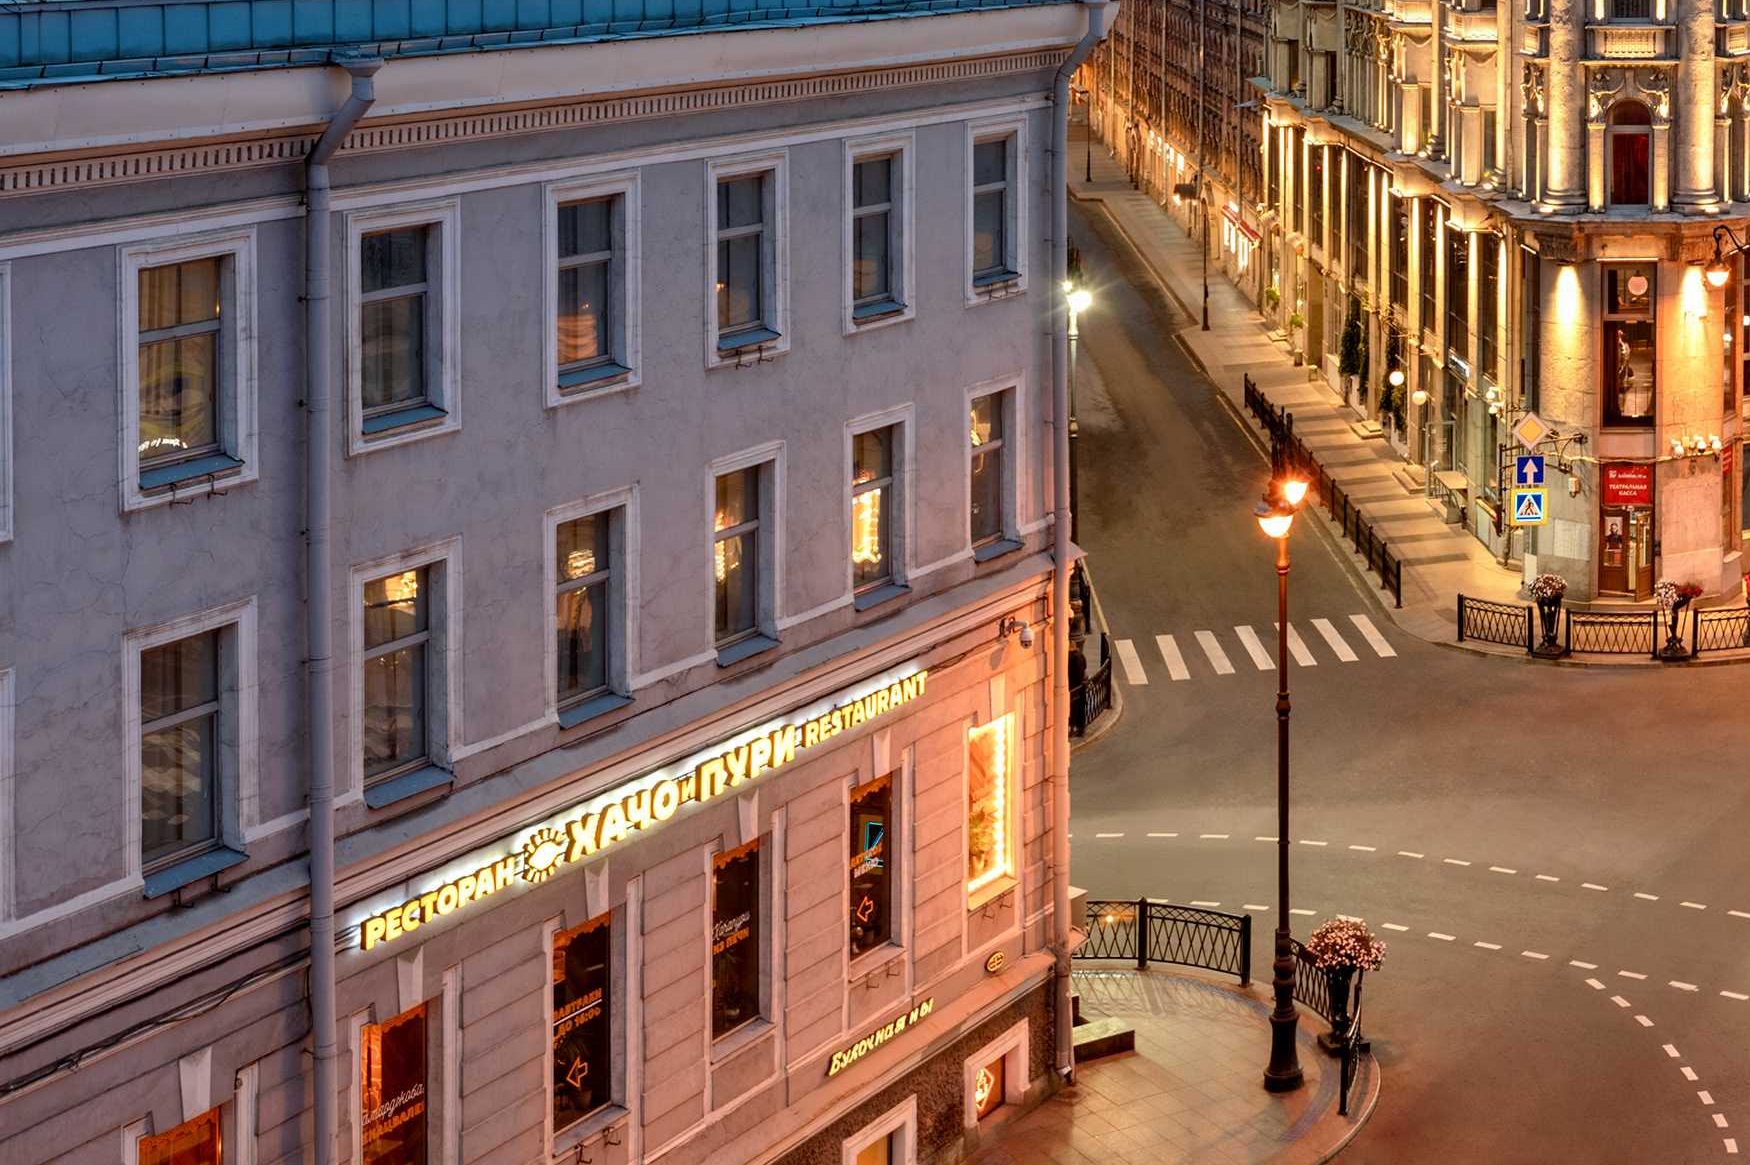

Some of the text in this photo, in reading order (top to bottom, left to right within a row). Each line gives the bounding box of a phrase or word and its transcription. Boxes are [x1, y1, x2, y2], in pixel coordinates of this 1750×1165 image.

[362, 856, 515, 951] РЕСТОРАН
[566, 779, 680, 863] ХАЧО
[696, 723, 795, 803] ПУРИ
[802, 670, 928, 748] RESTAURANT
[828, 1015, 907, 1076] Булочная
